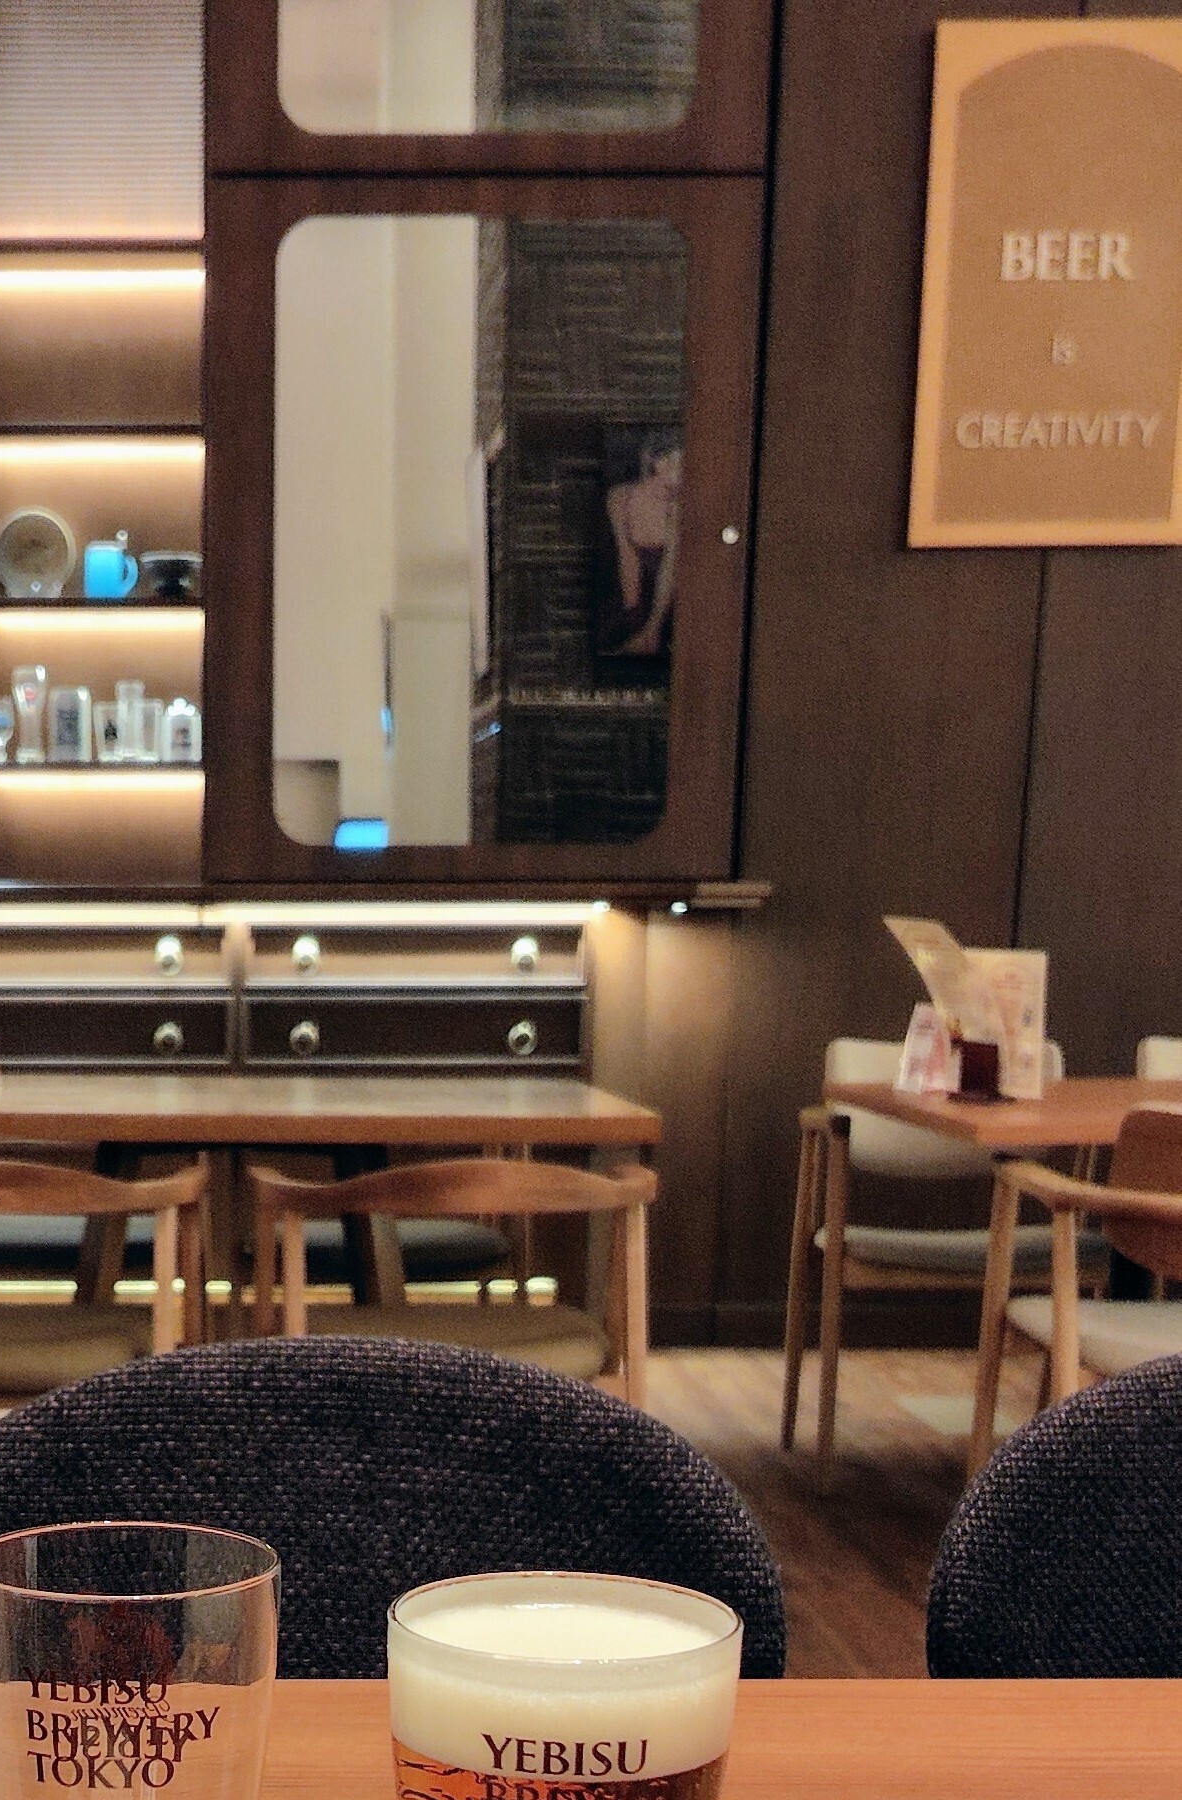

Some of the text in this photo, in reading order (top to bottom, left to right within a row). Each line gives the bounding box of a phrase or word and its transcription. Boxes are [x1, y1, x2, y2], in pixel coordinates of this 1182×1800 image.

[1000, 230, 1135, 281] BEER
[955, 411, 1161, 449] CREATIVITY
[24, 1666, 171, 1706] YEBISU
[25, 1705, 221, 1747] BREWERY
[26, 1750, 175, 1789] TOKYO
[481, 1733, 649, 1777] YEBISU
